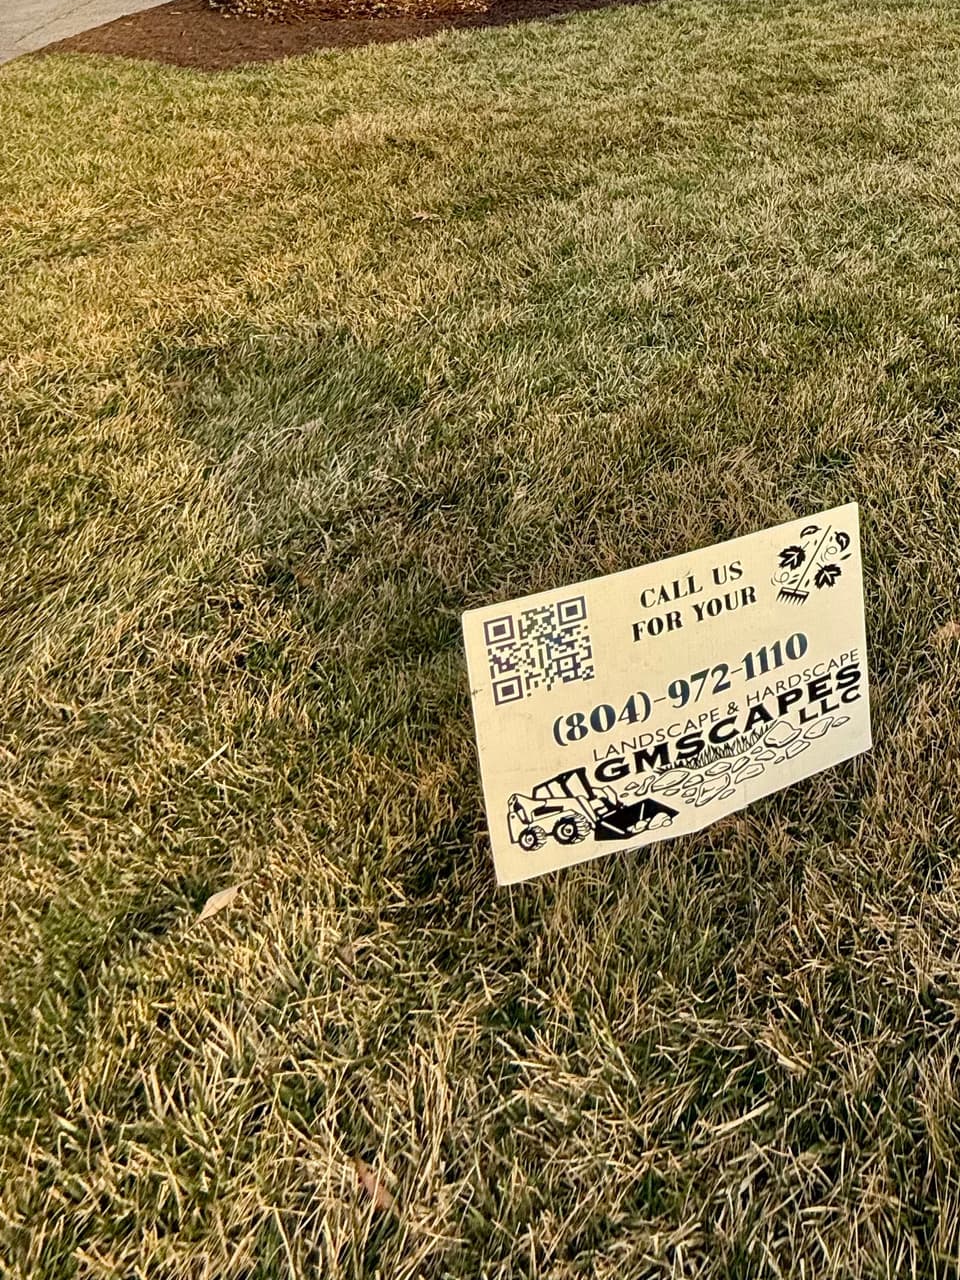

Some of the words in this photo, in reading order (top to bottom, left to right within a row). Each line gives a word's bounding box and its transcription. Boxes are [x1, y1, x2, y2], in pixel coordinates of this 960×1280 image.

[632, 610, 682, 643] FOR
[692, 586, 757, 624] YOUR
[640, 575, 703, 609] CALL
[713, 560, 745, 586] US
[552, 632, 809, 747] (804)-972-1110
[593, 708, 720, 762] LANDSCAPE
[728, 701, 740, 717] &
[746, 648, 860, 704] HARDSCAPE
[597, 662, 862, 783] GMSCAPES
[799, 686, 862, 723] LLC
